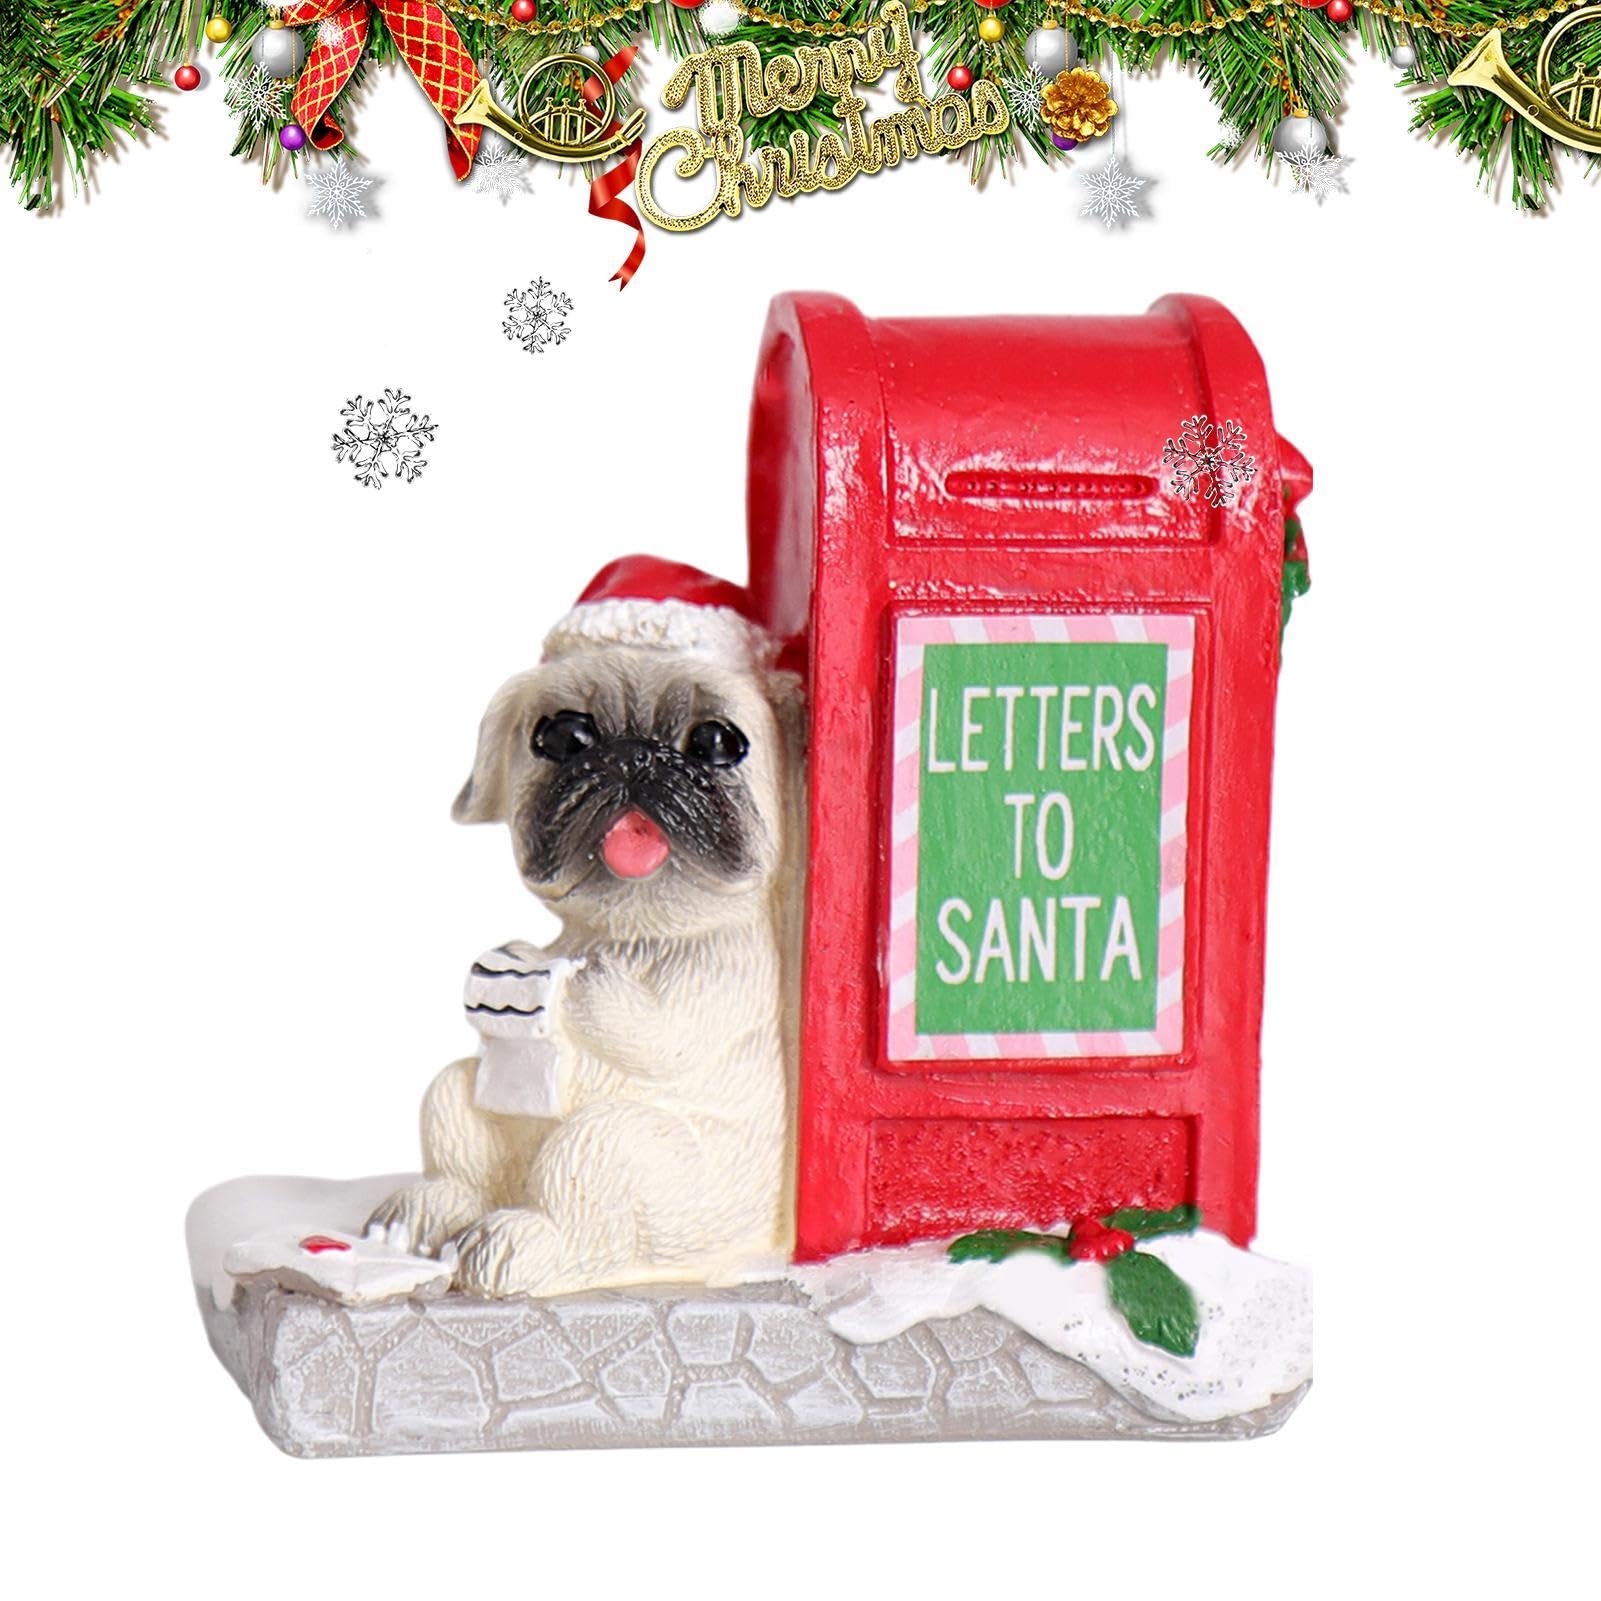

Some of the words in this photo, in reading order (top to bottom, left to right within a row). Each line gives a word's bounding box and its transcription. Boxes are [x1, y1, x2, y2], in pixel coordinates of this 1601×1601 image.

[927, 683, 1157, 773] LETTERS
[1004, 792, 1074, 880] TO
[935, 895, 1142, 984] SANTA
